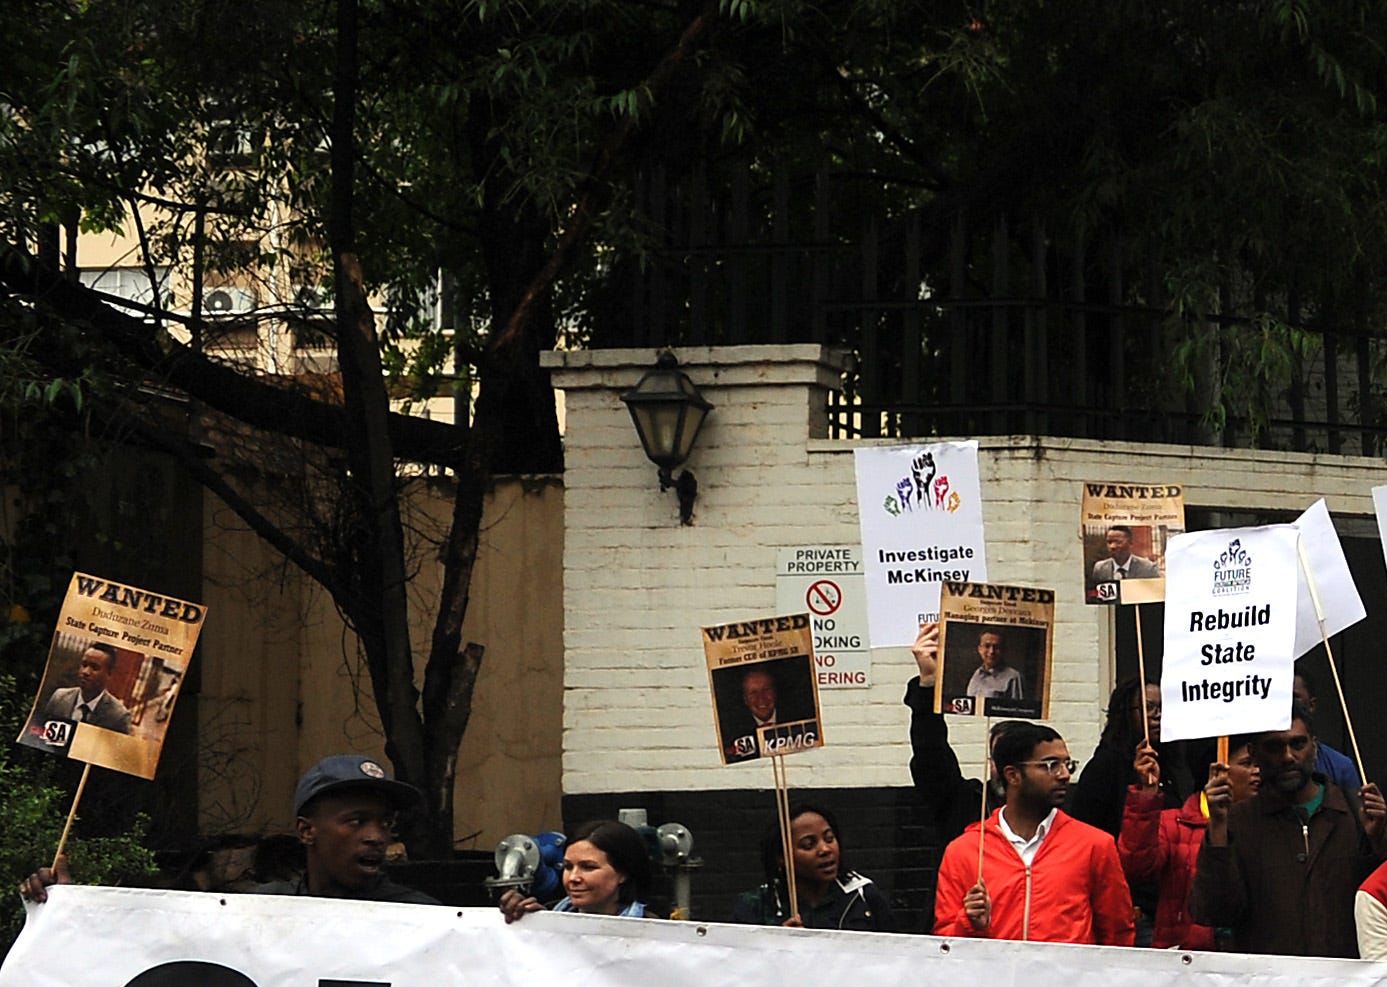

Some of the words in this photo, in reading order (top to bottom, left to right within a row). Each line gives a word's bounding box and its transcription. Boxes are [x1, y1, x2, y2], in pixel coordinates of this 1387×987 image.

[1086, 484, 1181, 498] WANTED
[796, 550, 851, 560] PRIVATE
[879, 546, 974, 564] Investigate
[788, 560, 860, 572] PROPERTY
[1214, 567, 1252, 582] FUTURE
[888, 568, 970, 584] McKinsey
[76, 575, 202, 625] WANTED
[946, 582, 1055, 604] WANTED
[814, 619, 836, 631] NO
[918, 614, 940, 624] FUTU
[1190, 604, 1271, 632] Rebuild
[66, 616, 86, 629] State
[88, 622, 120, 639] Capture
[122, 631, 152, 648] Project
[152, 640, 184, 656] Partner
[704, 614, 810, 642] WANTED
[814, 636, 861, 648] OKING
[1201, 642, 1256, 666] State
[818, 672, 866, 684] ERING
[1182, 675, 1272, 703] Integrity
[764, 732, 816, 752] KPMG
